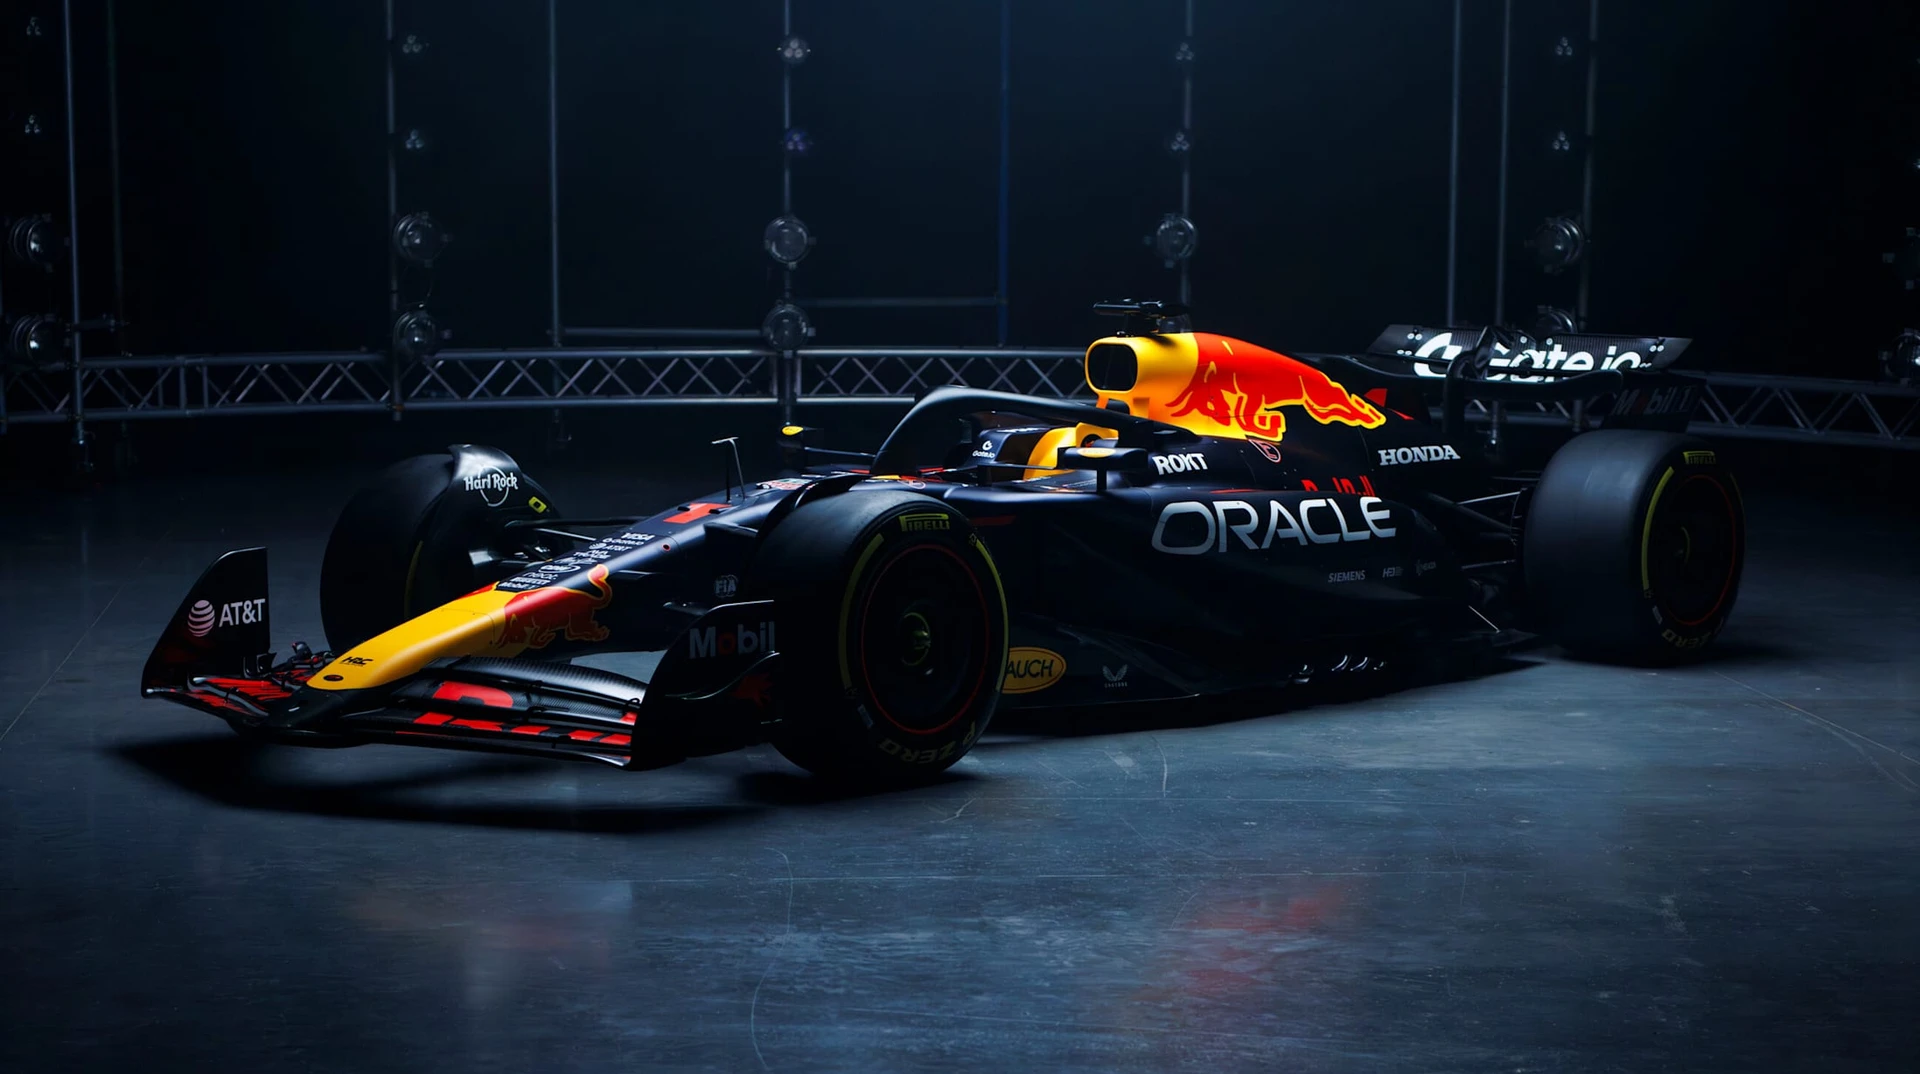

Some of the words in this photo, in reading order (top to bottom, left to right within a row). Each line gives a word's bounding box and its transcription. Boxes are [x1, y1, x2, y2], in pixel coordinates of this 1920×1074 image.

[1151, 452, 1208, 475] ROKT
[1377, 444, 1461, 466] HONDA
[492, 471, 519, 492] Rock
[898, 513, 950, 532] PIRELLI
[1152, 496, 1397, 555] ORACLE
[714, 578, 738, 595] FIA
[1328, 569, 1367, 583] SIEMENS
[218, 598, 266, 628] AT&T
[689, 621, 775, 659] Mobil
[1007, 659, 1055, 679] AUCH
[878, 737, 957, 764] ZERO
